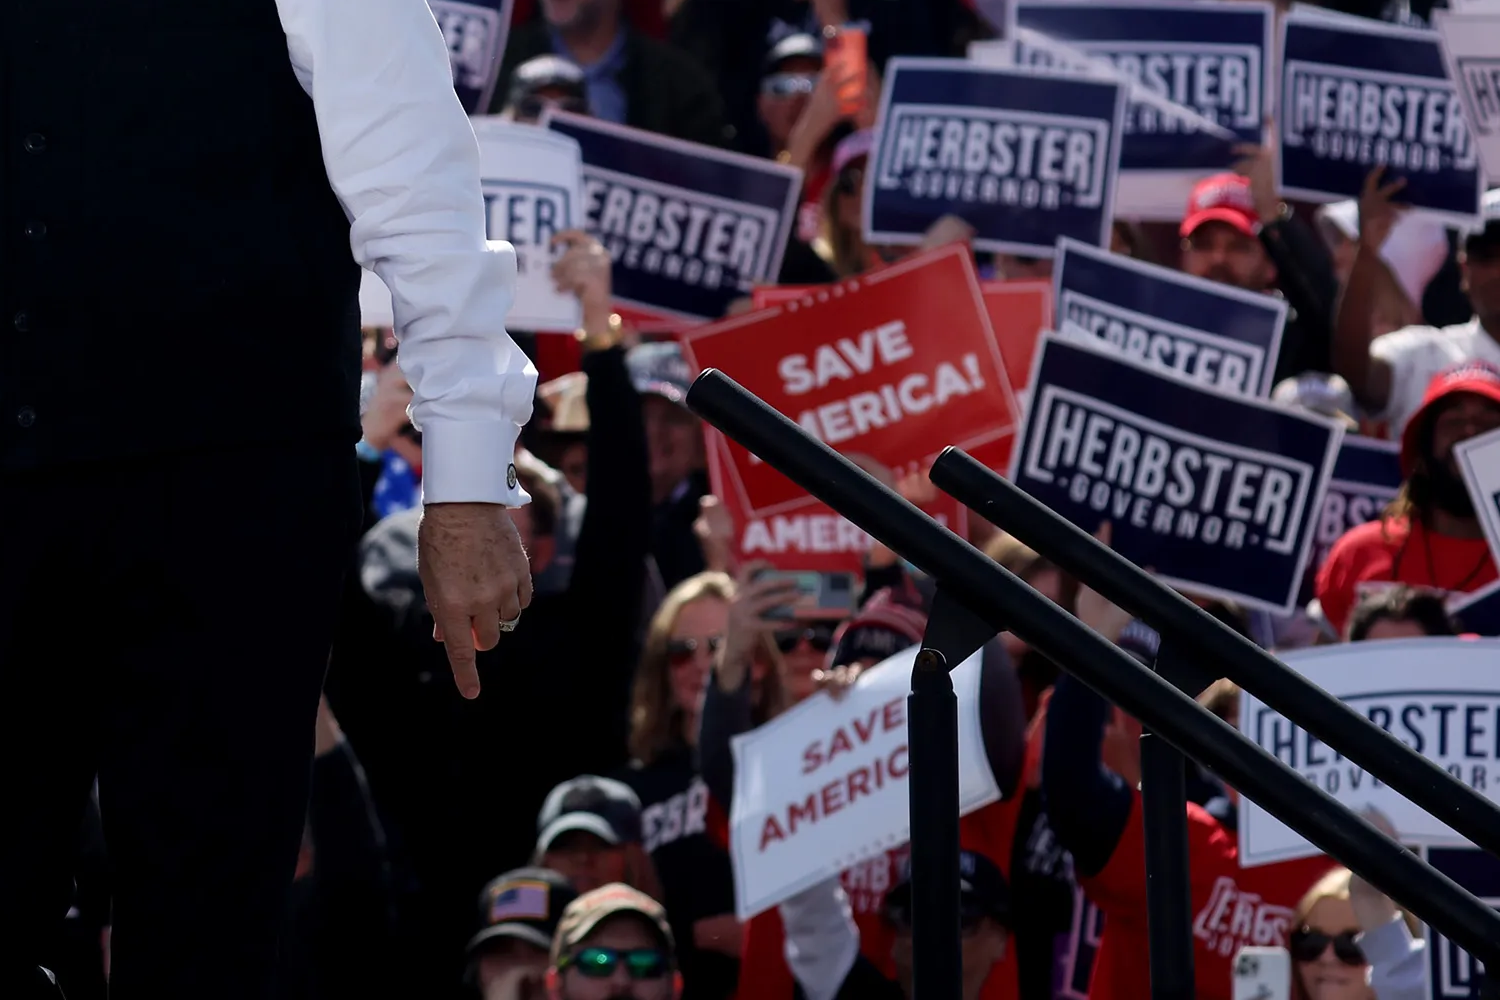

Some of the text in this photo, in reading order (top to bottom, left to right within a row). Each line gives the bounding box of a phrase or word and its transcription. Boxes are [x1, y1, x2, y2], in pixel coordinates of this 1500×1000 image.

[898, 118, 1094, 191] HERBSTER
[1299, 76, 1468, 164] HERBSTER
[584, 179, 761, 276] ERBSTER
[777, 319, 914, 396] SAVE
[1045, 401, 1292, 538] HERBSTER
[1070, 474, 1243, 551] GOVERNOR
[802, 695, 908, 775] SAVE
[758, 744, 909, 852] AMERIC
